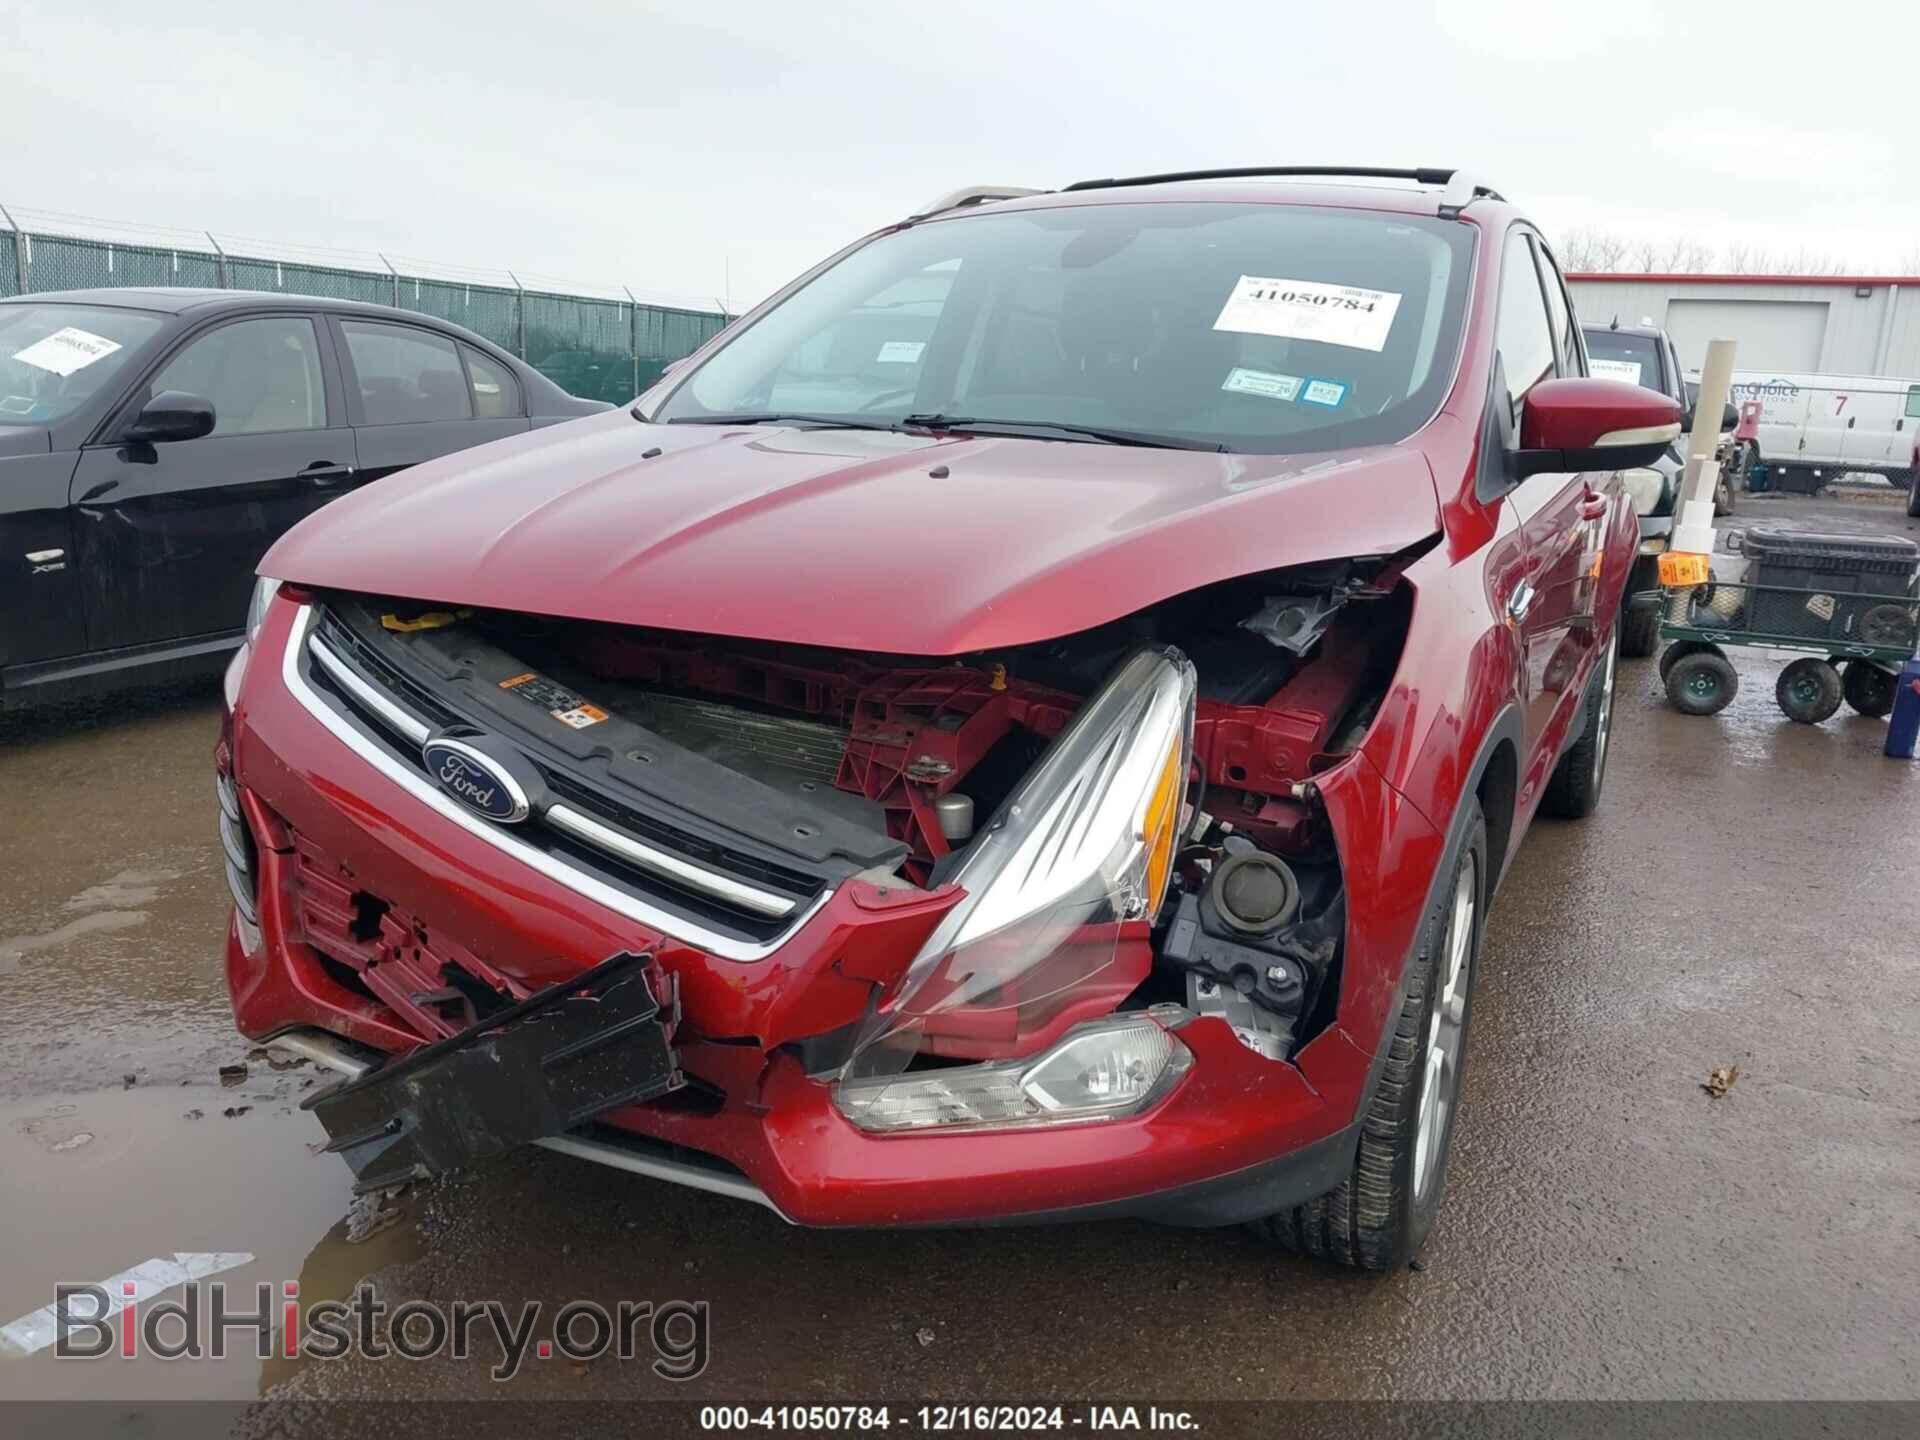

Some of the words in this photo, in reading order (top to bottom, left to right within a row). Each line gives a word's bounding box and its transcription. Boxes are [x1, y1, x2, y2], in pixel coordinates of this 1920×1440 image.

[1249, 289, 1375, 312] 41050784
[1836, 396, 1848, 416] 7
[440, 755, 494, 807] Ford
